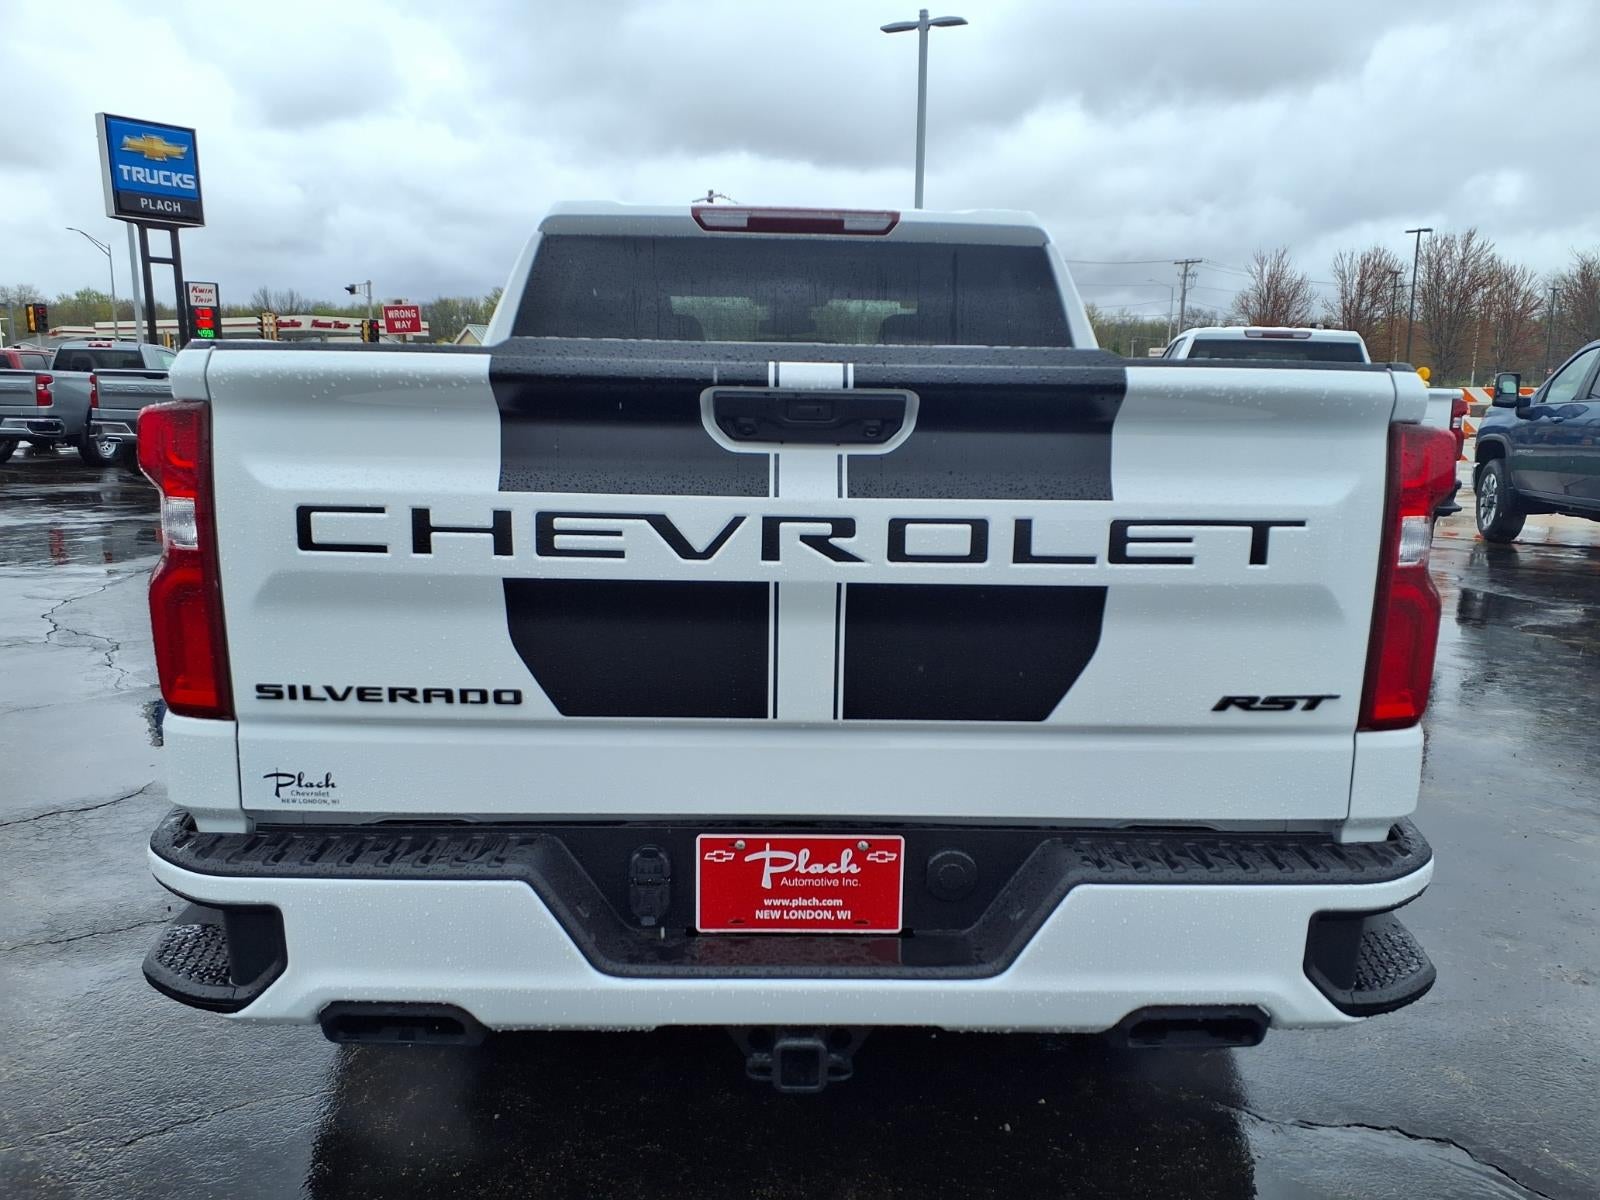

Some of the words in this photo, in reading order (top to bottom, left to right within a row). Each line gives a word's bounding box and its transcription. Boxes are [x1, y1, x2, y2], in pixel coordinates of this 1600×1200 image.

[118, 164, 196, 189] TRUCKS
[140, 197, 181, 212] PLACH
[387, 309, 417, 319] WRONG
[394, 320, 412, 329] WAY
[296, 505, 1307, 565] CHEVROLET
[255, 683, 523, 705] SILVERADO
[1211, 694, 1341, 712] RST
[263, 767, 336, 798] Plach
[290, 789, 330, 797] Chevrolet
[744, 842, 861, 889] Plach
[780, 877, 839, 887] Automotive
[842, 877, 861, 887] Inc.
[763, 897, 843, 908] www.plach.com
[755, 909, 781, 920] NEW
[783, 909, 835, 921] LONDON,
[836, 910, 851, 920] WI
